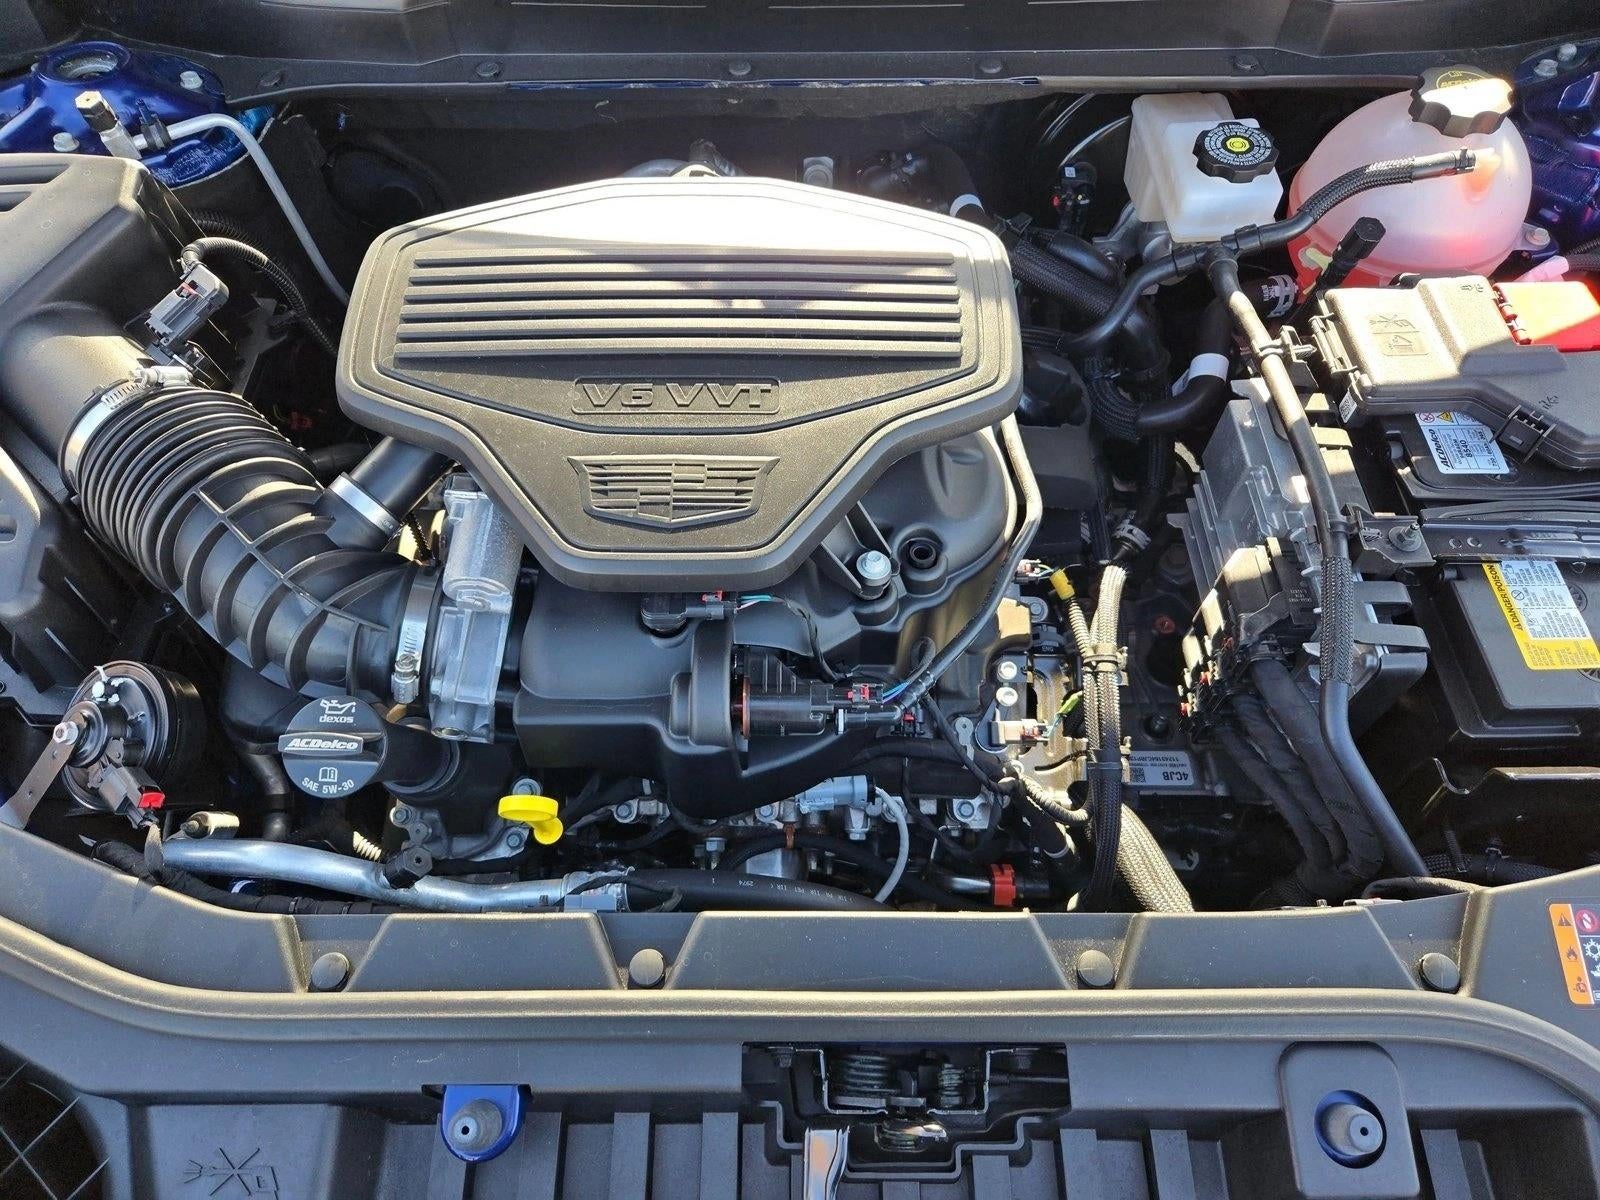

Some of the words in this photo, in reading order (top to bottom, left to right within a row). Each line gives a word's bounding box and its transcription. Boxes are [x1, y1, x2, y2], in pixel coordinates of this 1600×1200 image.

[582, 383, 654, 408] V6
[666, 383, 772, 408] VVT
[1429, 429, 1450, 468] ACDelco
[1460, 440, 1472, 458] 8540
[319, 714, 354, 724] dexos
[287, 738, 359, 750] ACDelco
[1162, 771, 1189, 781] 4CJB
[302, 777, 320, 792] SAE
[322, 779, 355, 794] 5W-30
